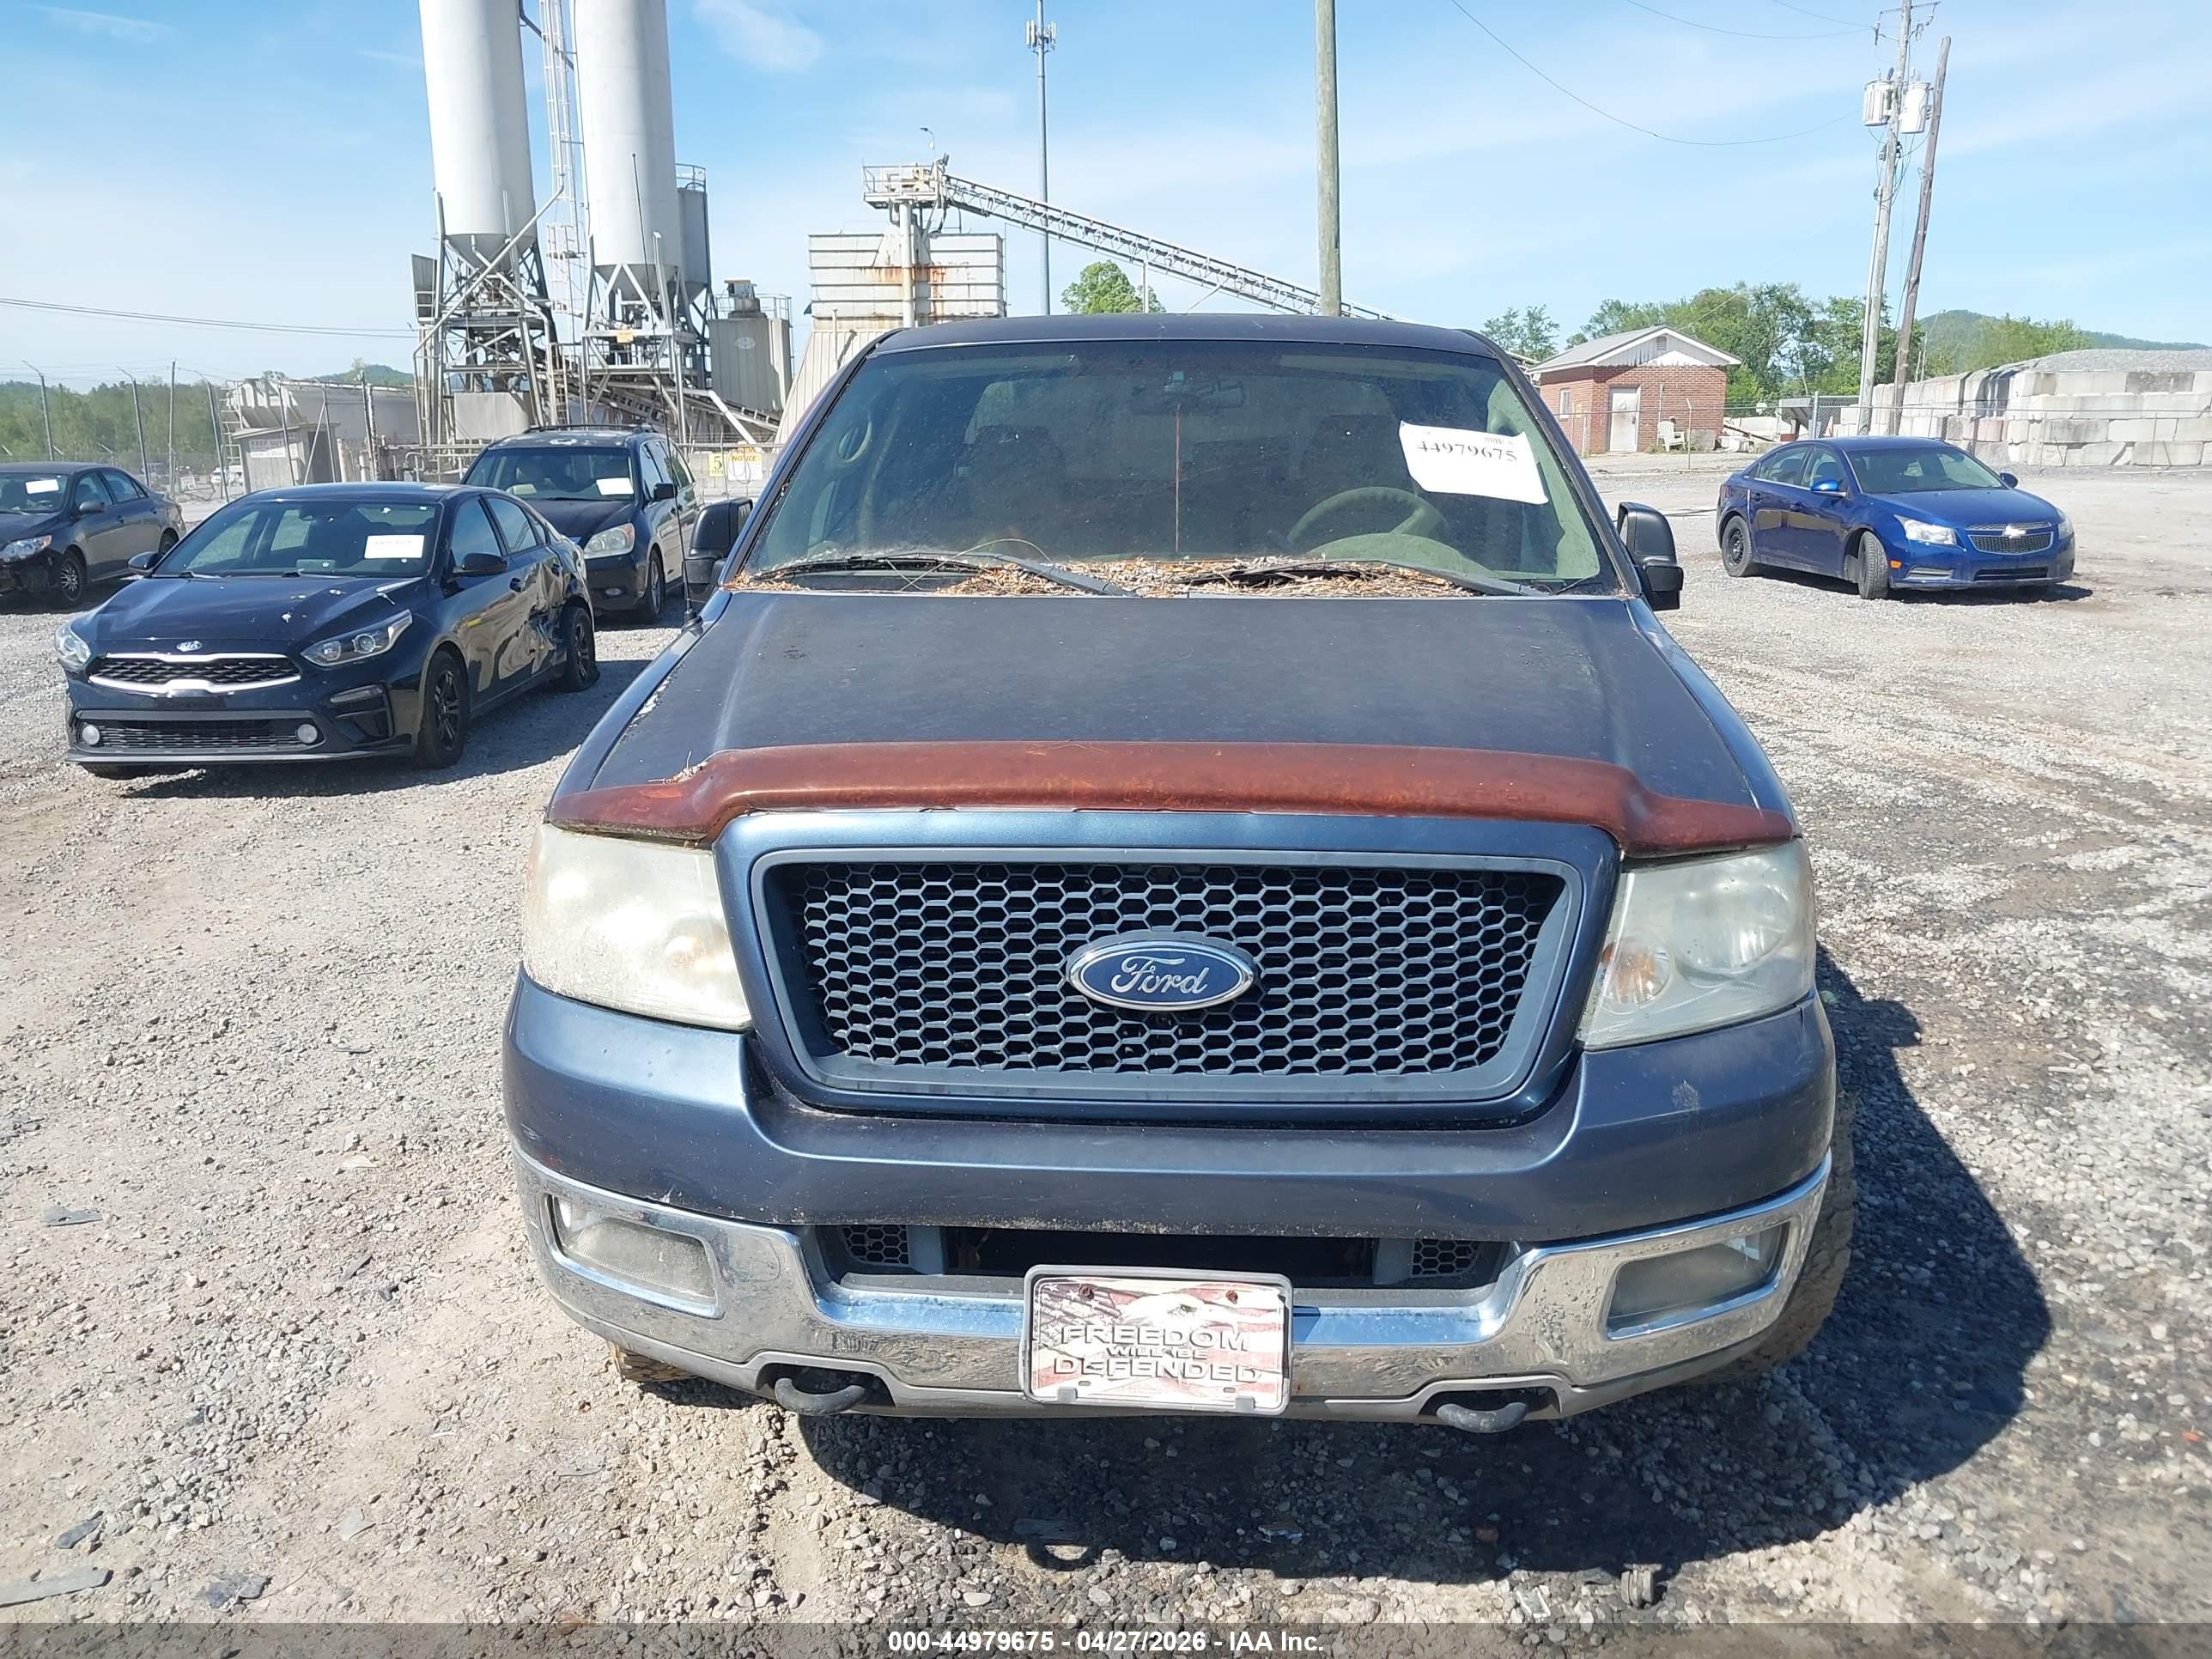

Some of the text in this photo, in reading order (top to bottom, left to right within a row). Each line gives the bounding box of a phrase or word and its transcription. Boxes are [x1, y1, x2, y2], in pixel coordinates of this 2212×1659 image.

[714, 455, 722, 469] 5
[1418, 441, 1517, 462] 44979675
[1110, 956, 1210, 994] Ford
[1060, 1324, 1251, 1352] FREEDOM
[1105, 1346, 1209, 1360] WILL BE
[1054, 1357, 1261, 1383] DEFENDED
